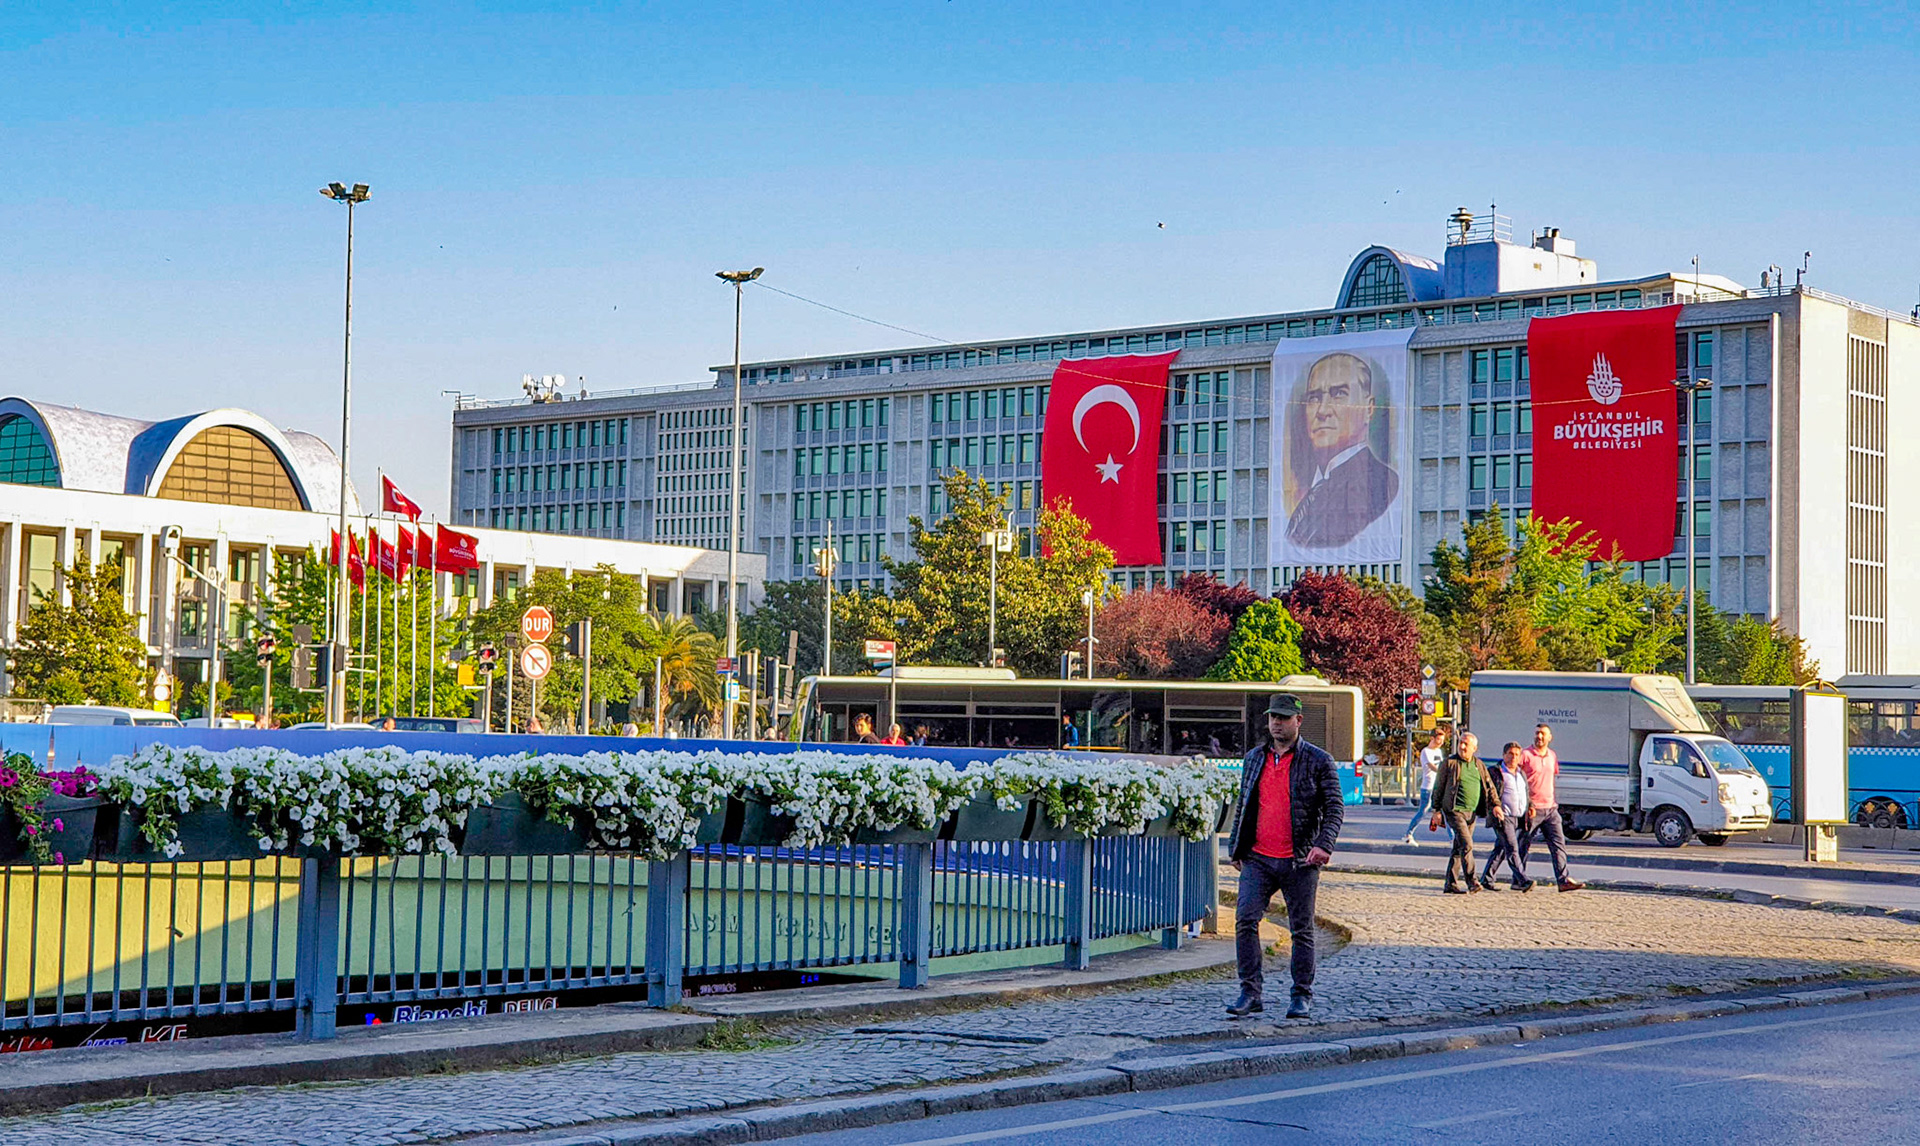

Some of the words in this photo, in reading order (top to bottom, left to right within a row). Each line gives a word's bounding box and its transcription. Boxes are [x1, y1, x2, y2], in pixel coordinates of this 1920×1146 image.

[1573, 411, 1641, 421] İSTANBUL
[1553, 416, 1663, 442] BÜYÜKŞEHİR
[1573, 439, 1642, 449] BELEDİYESİ
[525, 617, 550, 632] DUR
[1538, 708, 1577, 717] NAKLİYECİ
